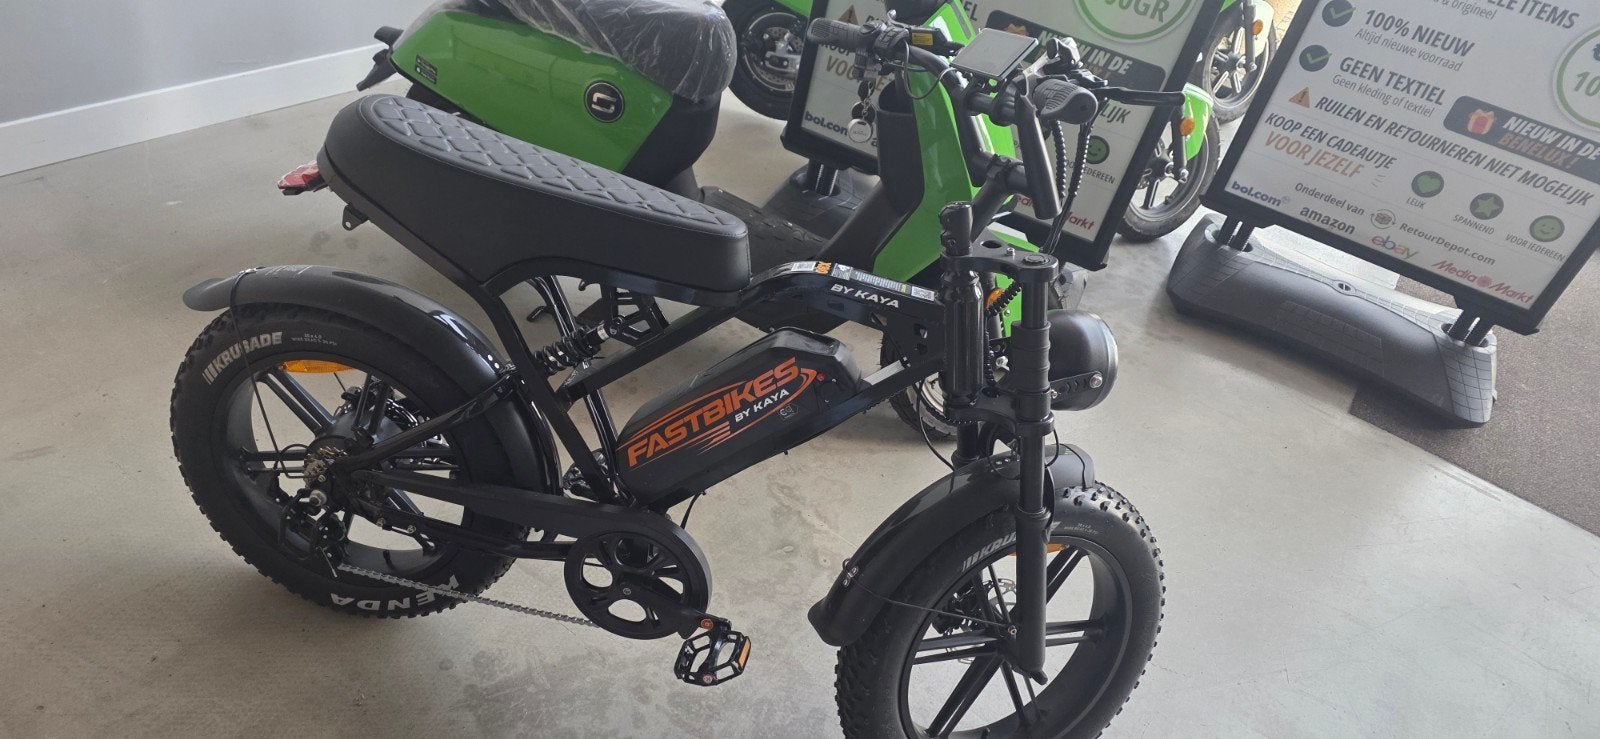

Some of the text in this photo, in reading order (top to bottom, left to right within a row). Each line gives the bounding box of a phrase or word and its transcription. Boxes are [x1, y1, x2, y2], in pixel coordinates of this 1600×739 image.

[1451, 0, 1497, 20] origineel
[1518, 0, 1580, 29] ITEMS
[1355, 28, 1464, 72] Altijd nieuwe voorraad
[1365, 9, 1475, 57] 100% NIEUW
[1107, 55, 1133, 75] DE
[1339, 57, 1446, 106] GEEN TEXTIEL
[1332, 74, 1435, 118] Geen kleding of textiel
[1264, 112, 1398, 170] KOOP EEN CADEAUTJE
[1314, 96, 1595, 206] RUILEN EN RETOURNEREN NIET MOGELIJK
[1502, 116, 1563, 145] NIEUW
[1556, 135, 1584, 153] IN
[1265, 130, 1365, 178] VOOR JEZELF
[1083, 166, 1116, 185] EDEREEN
[1231, 180, 1282, 207] bol.com
[1405, 197, 1427, 210] LEUK
[1294, 182, 1496, 266] Onderdeel van RetourDepot.com
[1299, 205, 1356, 235] amazon
[1452, 214, 1495, 236] SPANNEND
[1371, 235, 1419, 260] ebay
[1505, 233, 1567, 262] VOOR IEDEREEN
[830, 283, 900, 308] BY KAYA
[1431, 260, 1535, 304] Media Markt
[627, 356, 799, 468] FASTBIKES
[734, 408, 751, 423] BY
[753, 388, 790, 413] KAYA
